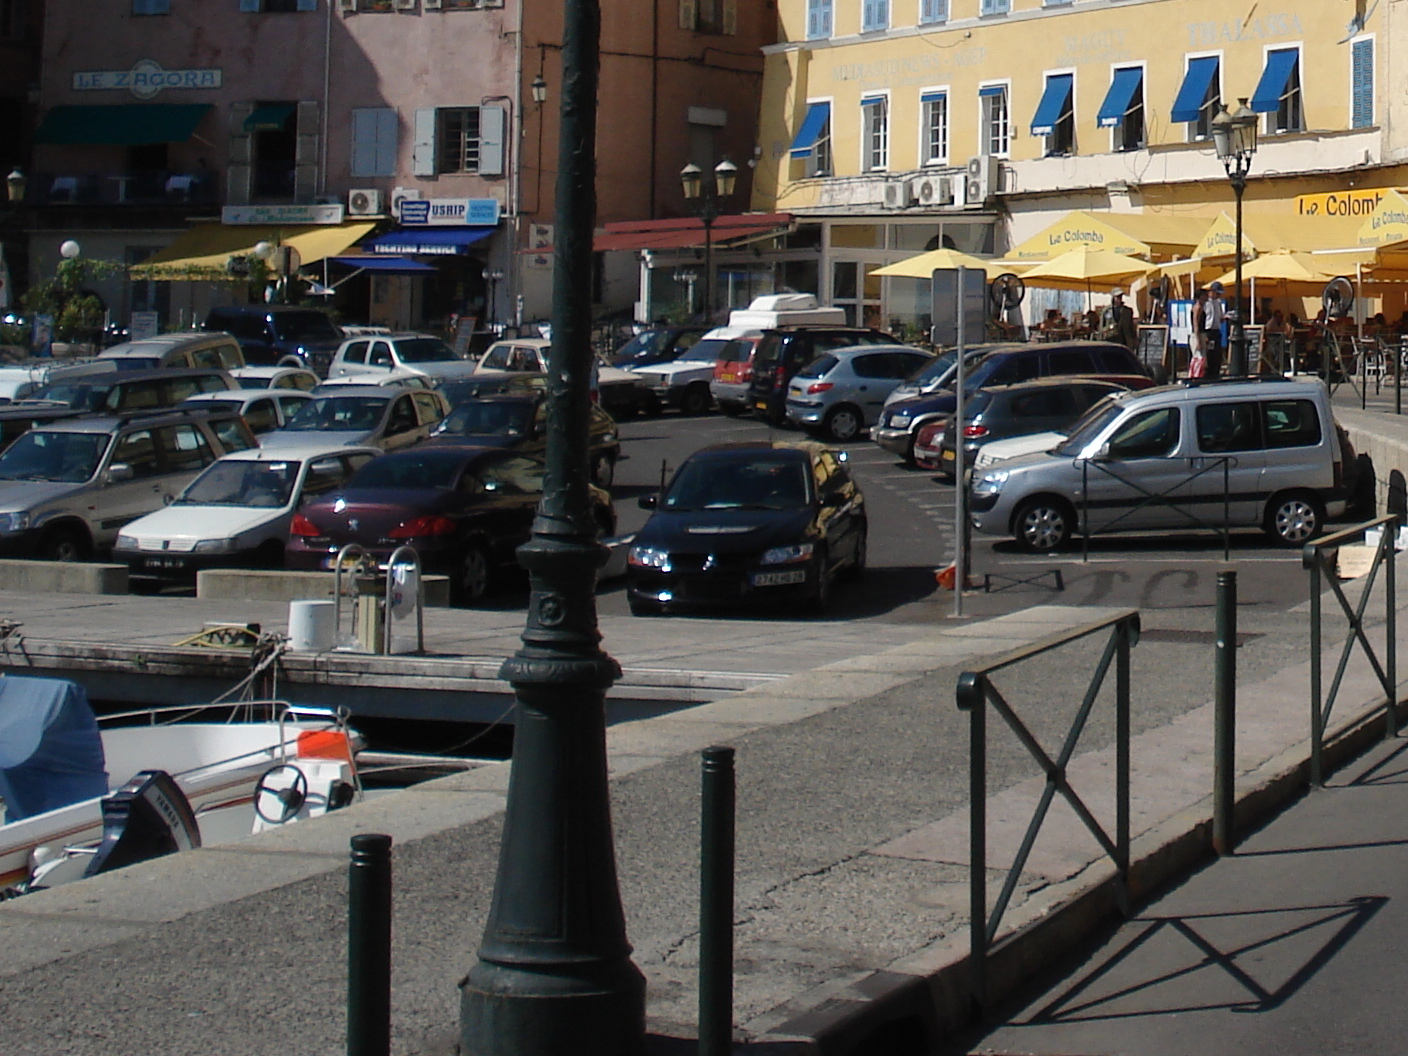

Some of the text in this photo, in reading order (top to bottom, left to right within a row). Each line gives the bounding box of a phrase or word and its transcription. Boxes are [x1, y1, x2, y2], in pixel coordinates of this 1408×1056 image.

[1187, 13, 1304, 46] THALASSA
[78, 71, 215, 87] LE ZAGORA
[432, 205, 465, 215] USHIP
[1064, 230, 1103, 244] Colomba
[156, 794, 179, 829] YAMAHA
